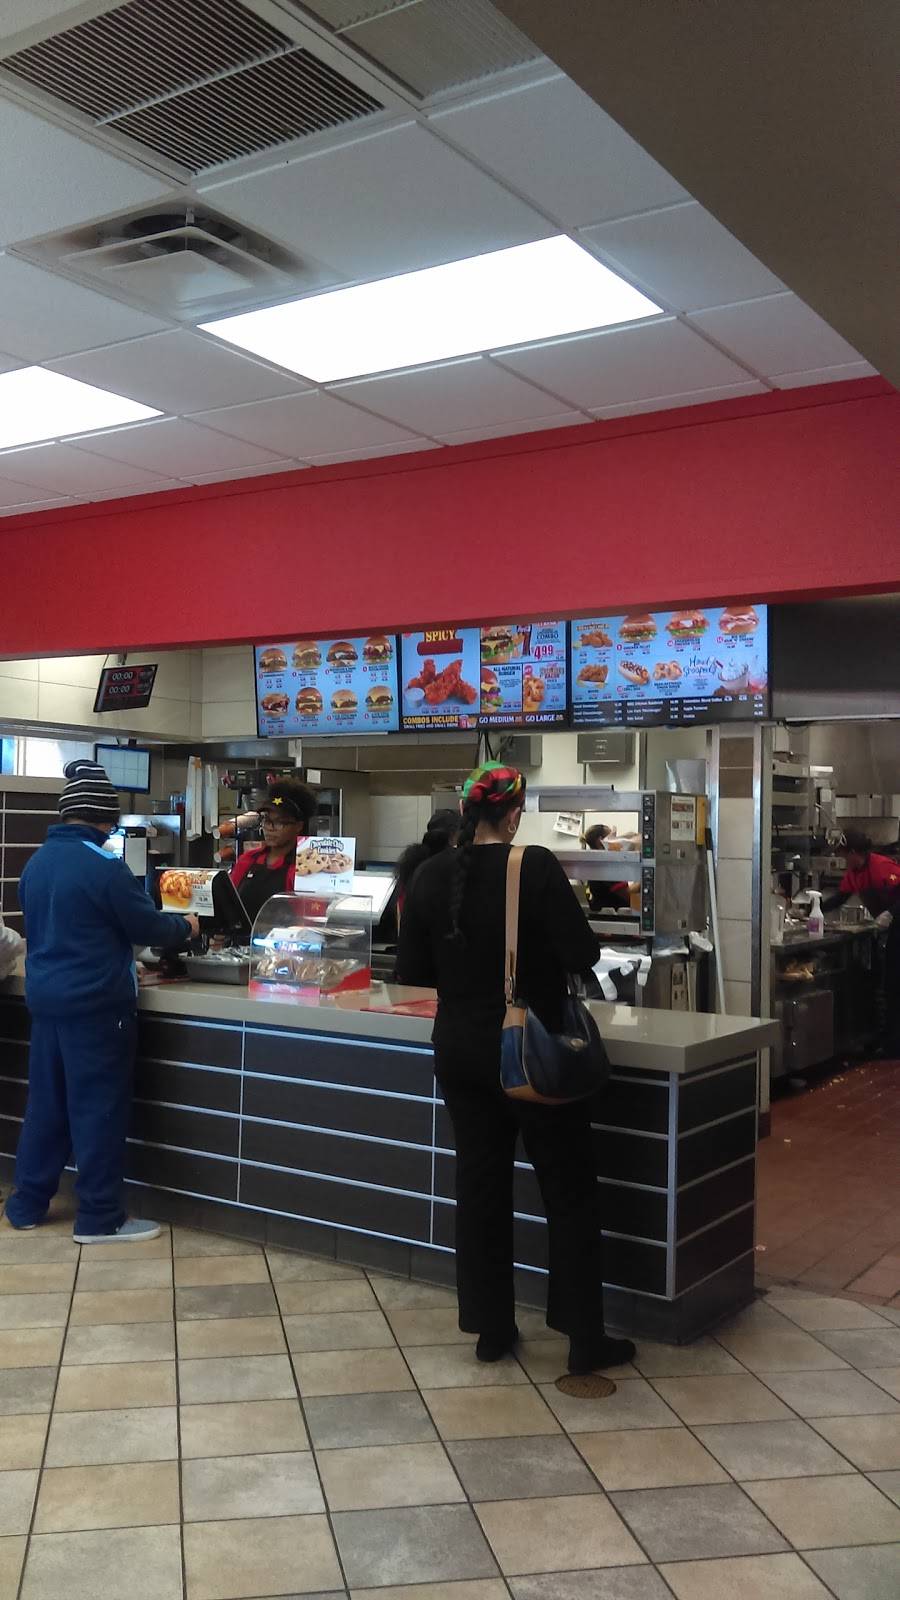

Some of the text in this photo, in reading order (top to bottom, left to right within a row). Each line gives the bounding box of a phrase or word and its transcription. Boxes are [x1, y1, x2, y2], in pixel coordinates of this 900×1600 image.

[425, 630, 455, 642] SPICY
[112, 672, 133, 680] 00:00
[403, 715, 458, 724] COMBOS INCLUDE
[489, 715, 515, 723] MEDIUM
[310, 838, 332, 849] Chocolate
